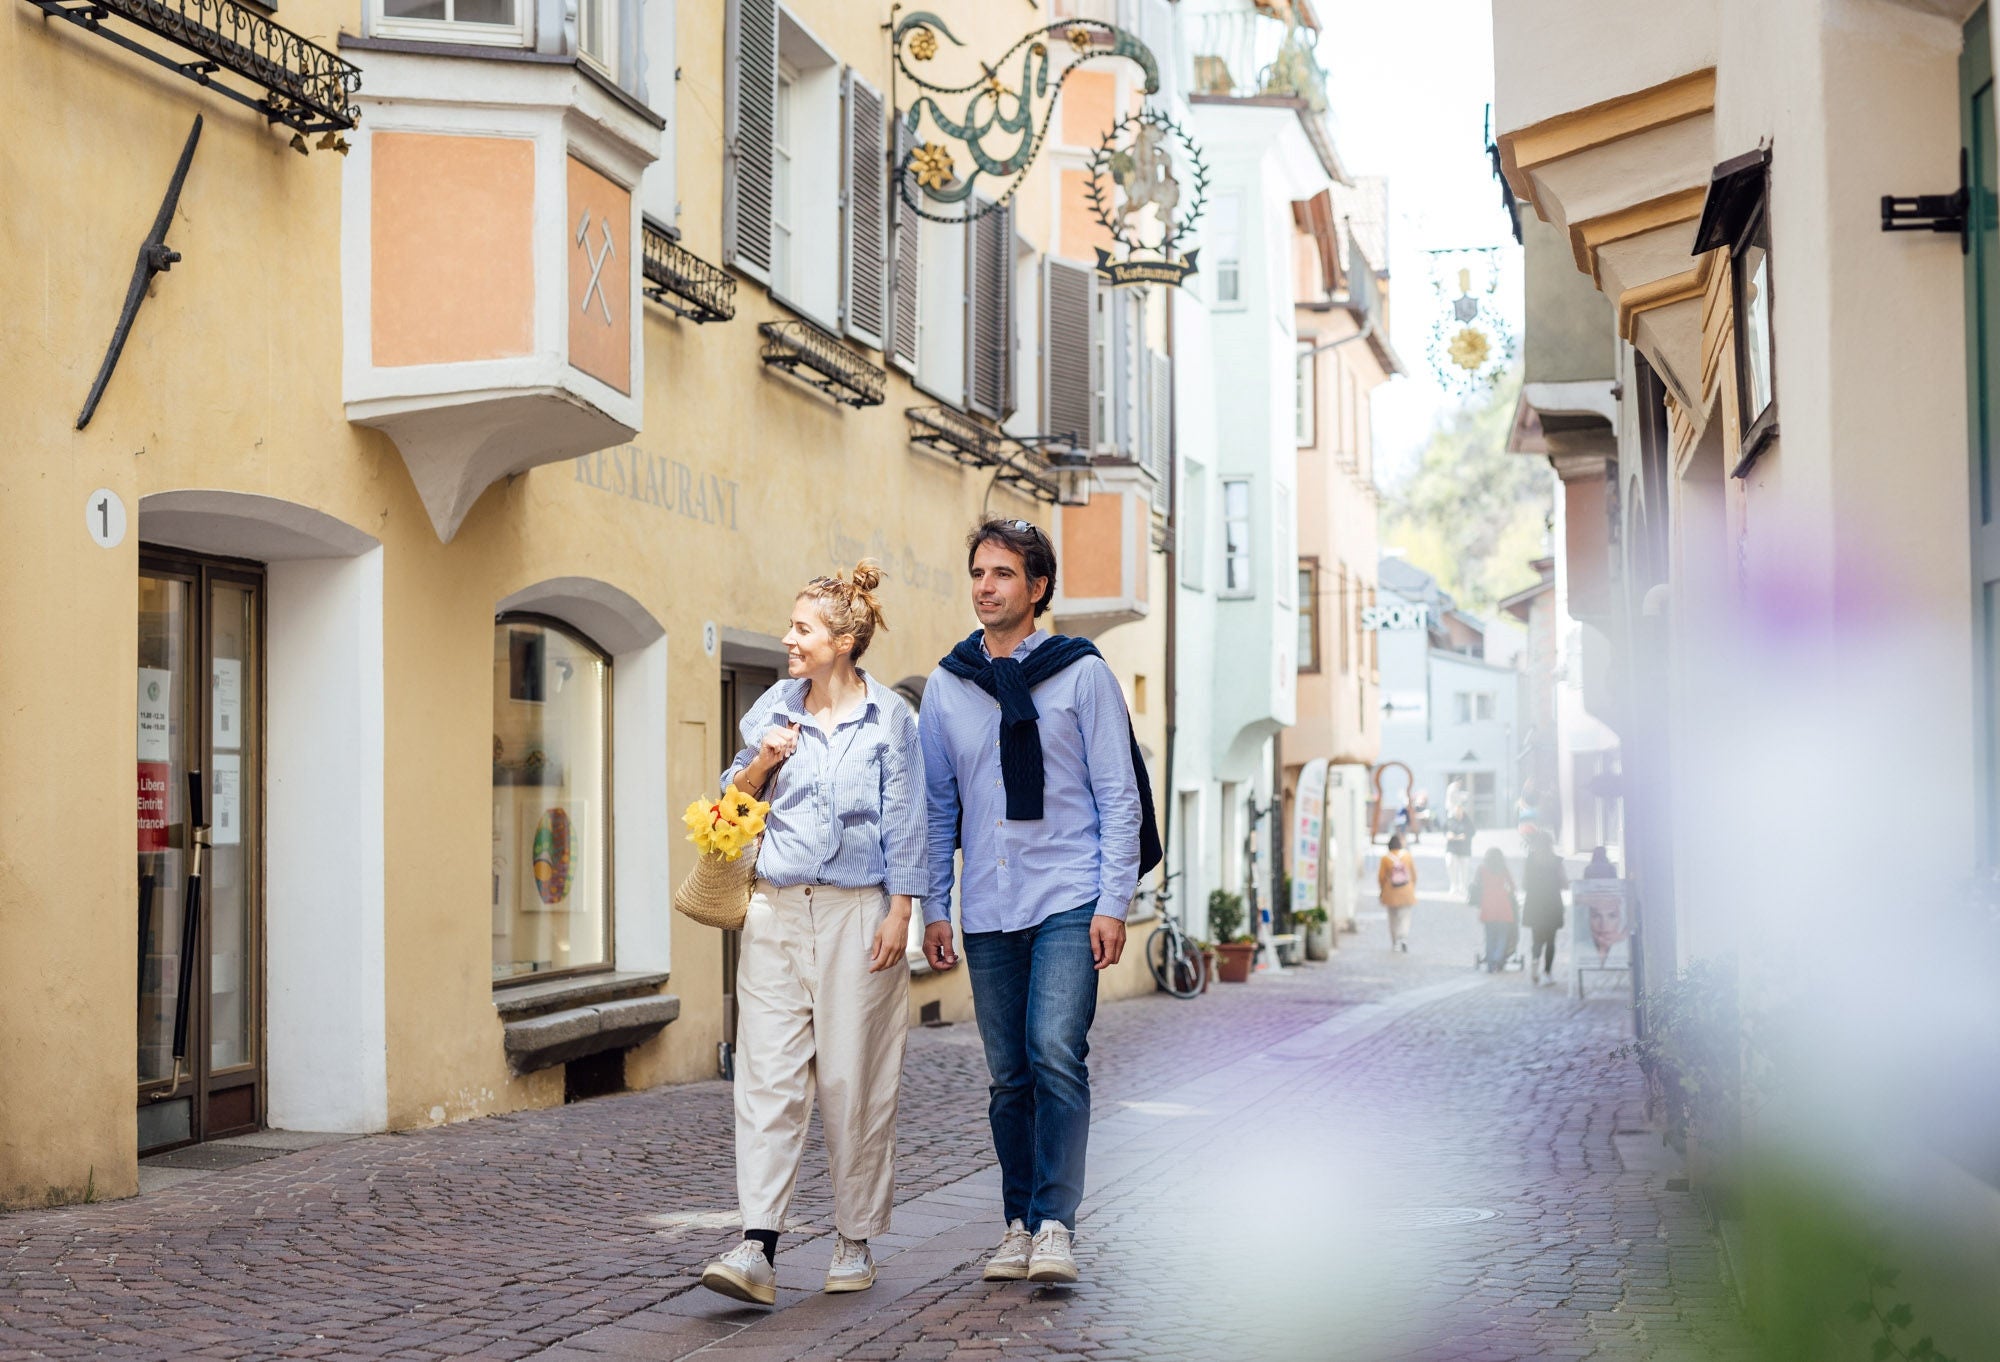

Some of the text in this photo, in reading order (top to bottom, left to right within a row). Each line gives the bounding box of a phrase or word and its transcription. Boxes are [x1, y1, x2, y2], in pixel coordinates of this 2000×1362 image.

[574, 444, 740, 531] RESTAURANT
[97, 498, 108, 538] 1
[1361, 602, 1429, 631] SPORT
[706, 627, 713, 650] 3
[140, 778, 165, 791] Libera
[137, 797, 163, 809] Eintritt
[137, 816, 165, 828] ntrance
